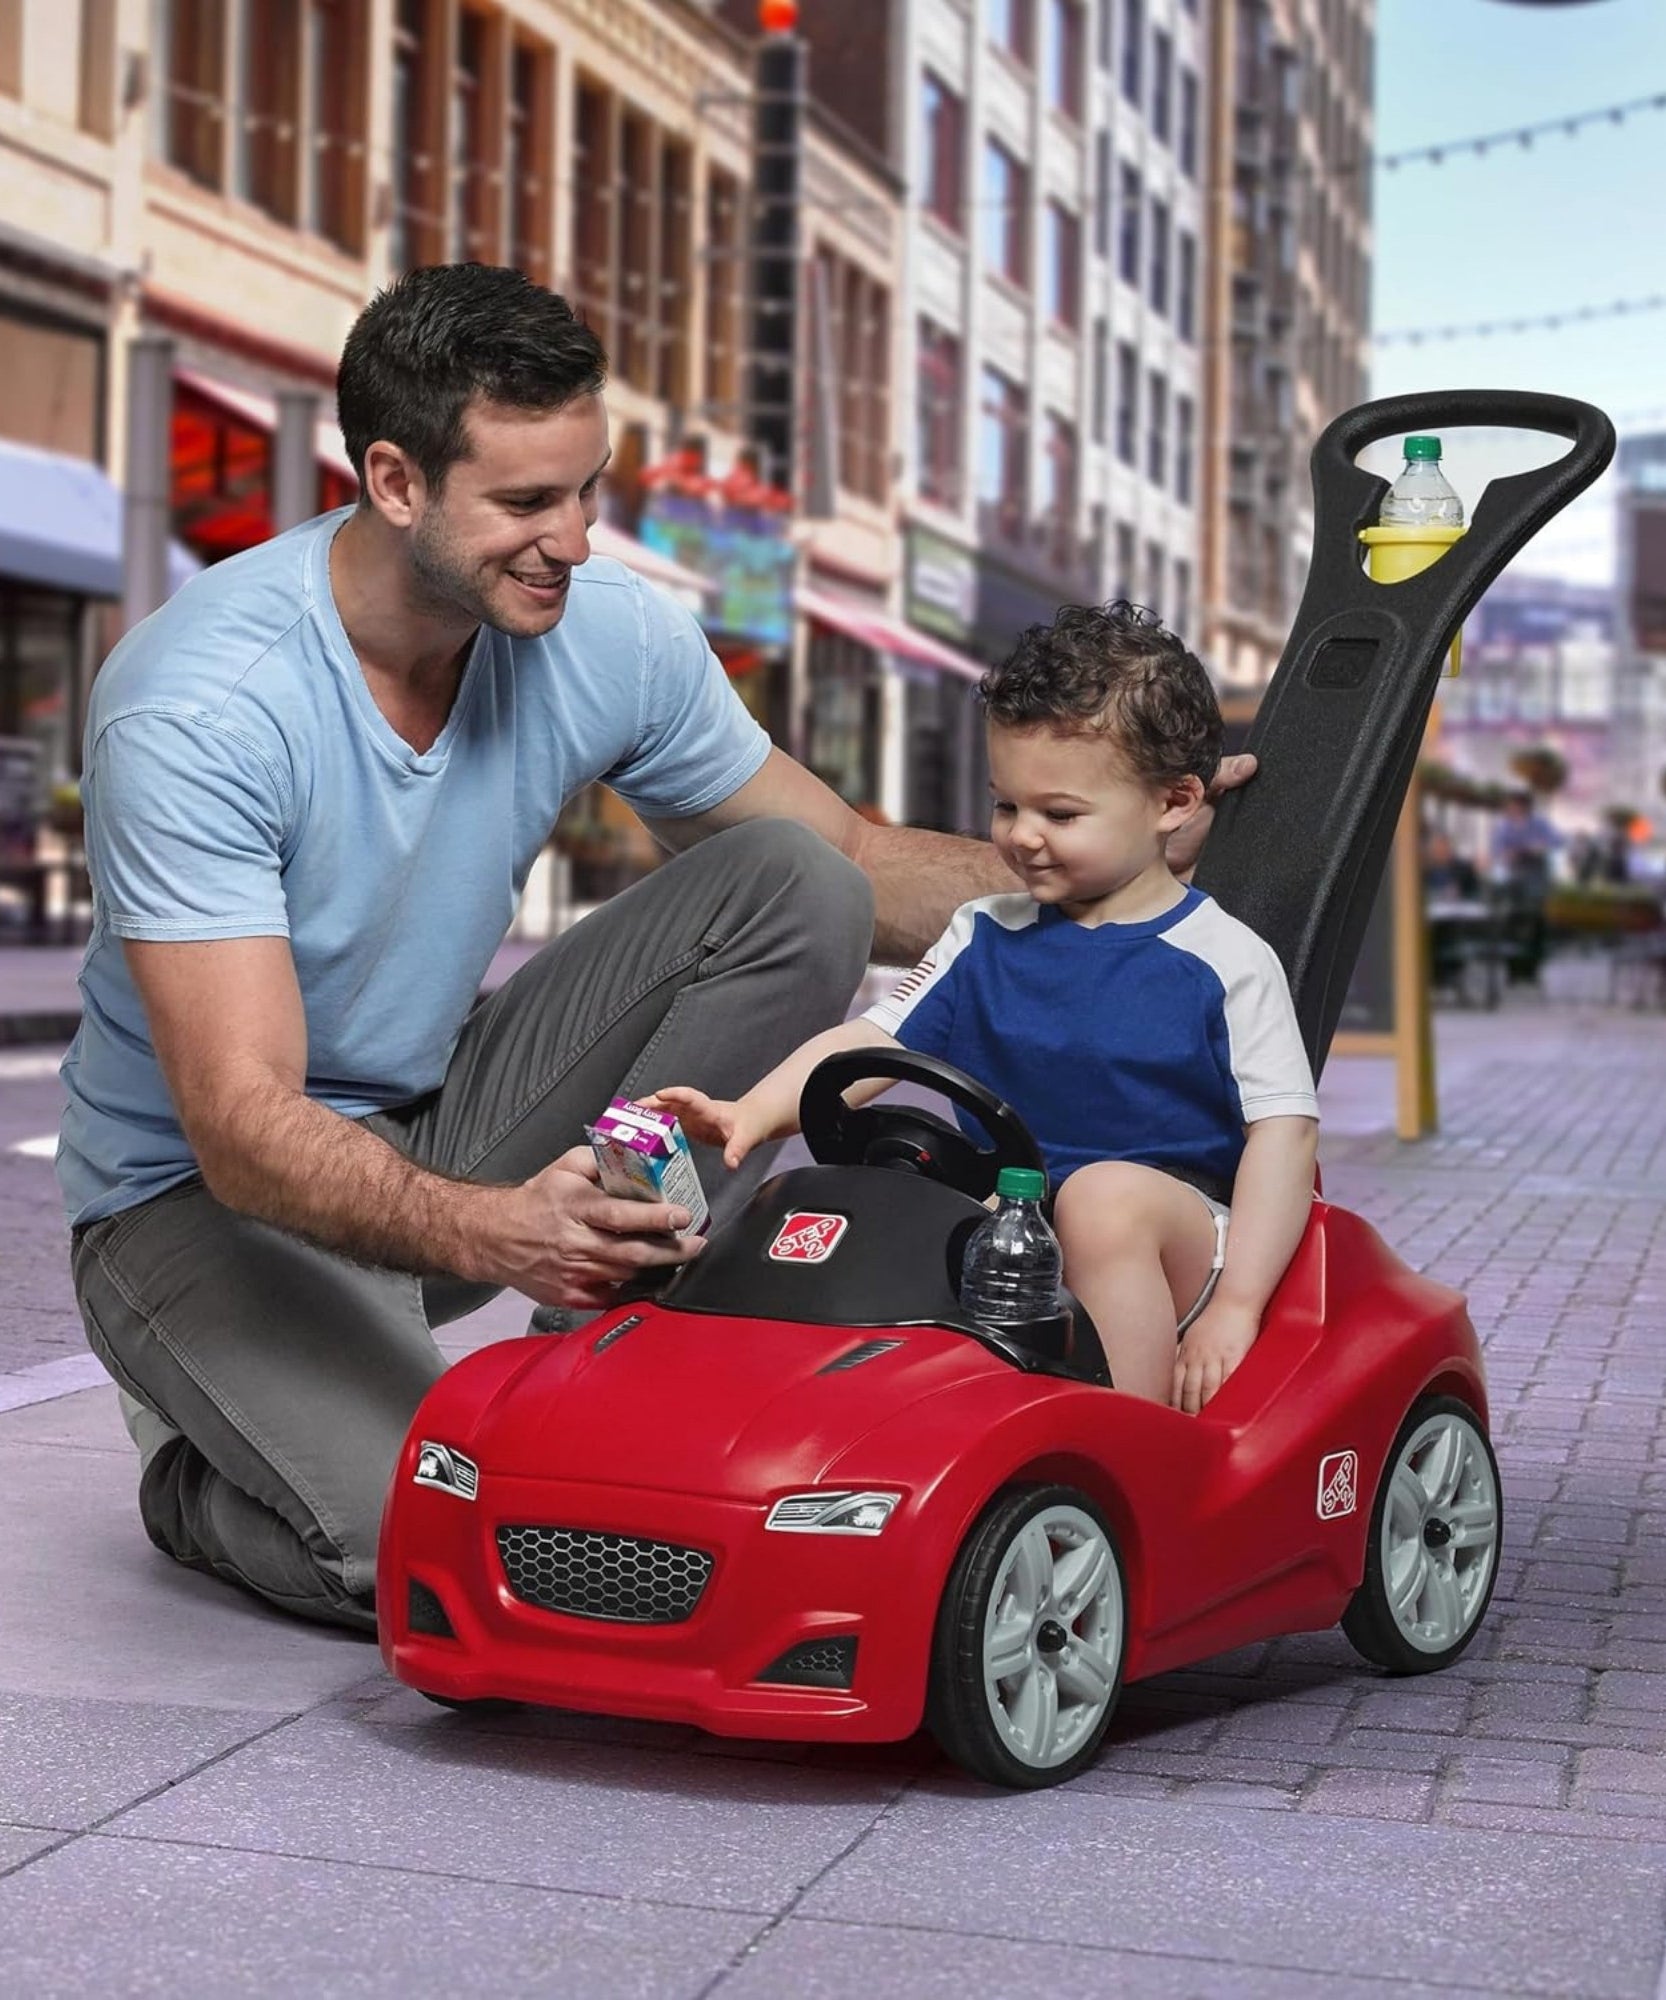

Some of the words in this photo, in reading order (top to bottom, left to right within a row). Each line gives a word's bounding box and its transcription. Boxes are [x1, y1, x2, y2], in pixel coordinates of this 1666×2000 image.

[777, 1218, 837, 1255] STEP
[804, 1238, 826, 1258] 2
[1323, 1455, 1353, 1513] STEP
[1340, 1485, 1354, 1510] 2
